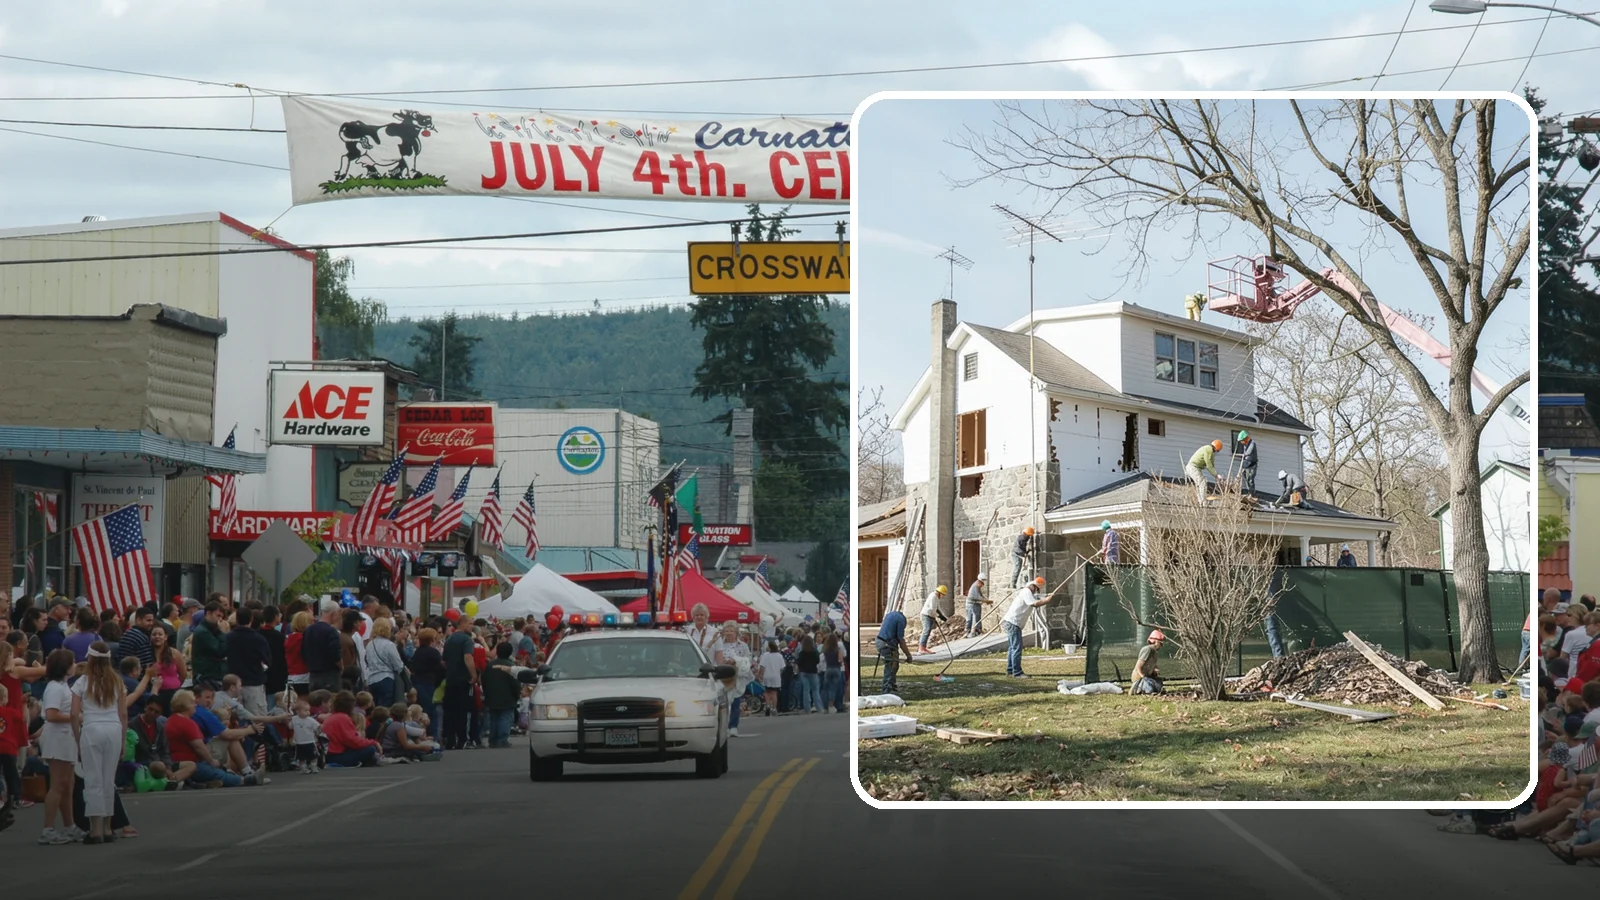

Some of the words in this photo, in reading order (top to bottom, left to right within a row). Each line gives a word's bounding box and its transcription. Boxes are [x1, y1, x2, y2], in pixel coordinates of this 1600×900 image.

[481, 140, 604, 192] JULY
[632, 150, 747, 198] 4th.
[697, 254, 850, 280] CROSSWA
[283, 380, 373, 420] ACE
[405, 409, 452, 422] CEDAR
[283, 421, 370, 436] Hardware
[416, 428, 476, 447] Coca-Cola
[353, 467, 385, 480] Simpl
[83, 485, 93, 494] St.
[96, 485, 124, 495] Vincent
[126, 486, 136, 495] de
[138, 486, 155, 495] Paul
[81, 503, 154, 522] THT
[212, 516, 331, 535] HARDARE
[688, 526, 741, 535] CRNATION
[699, 535, 730, 543] GLASS
